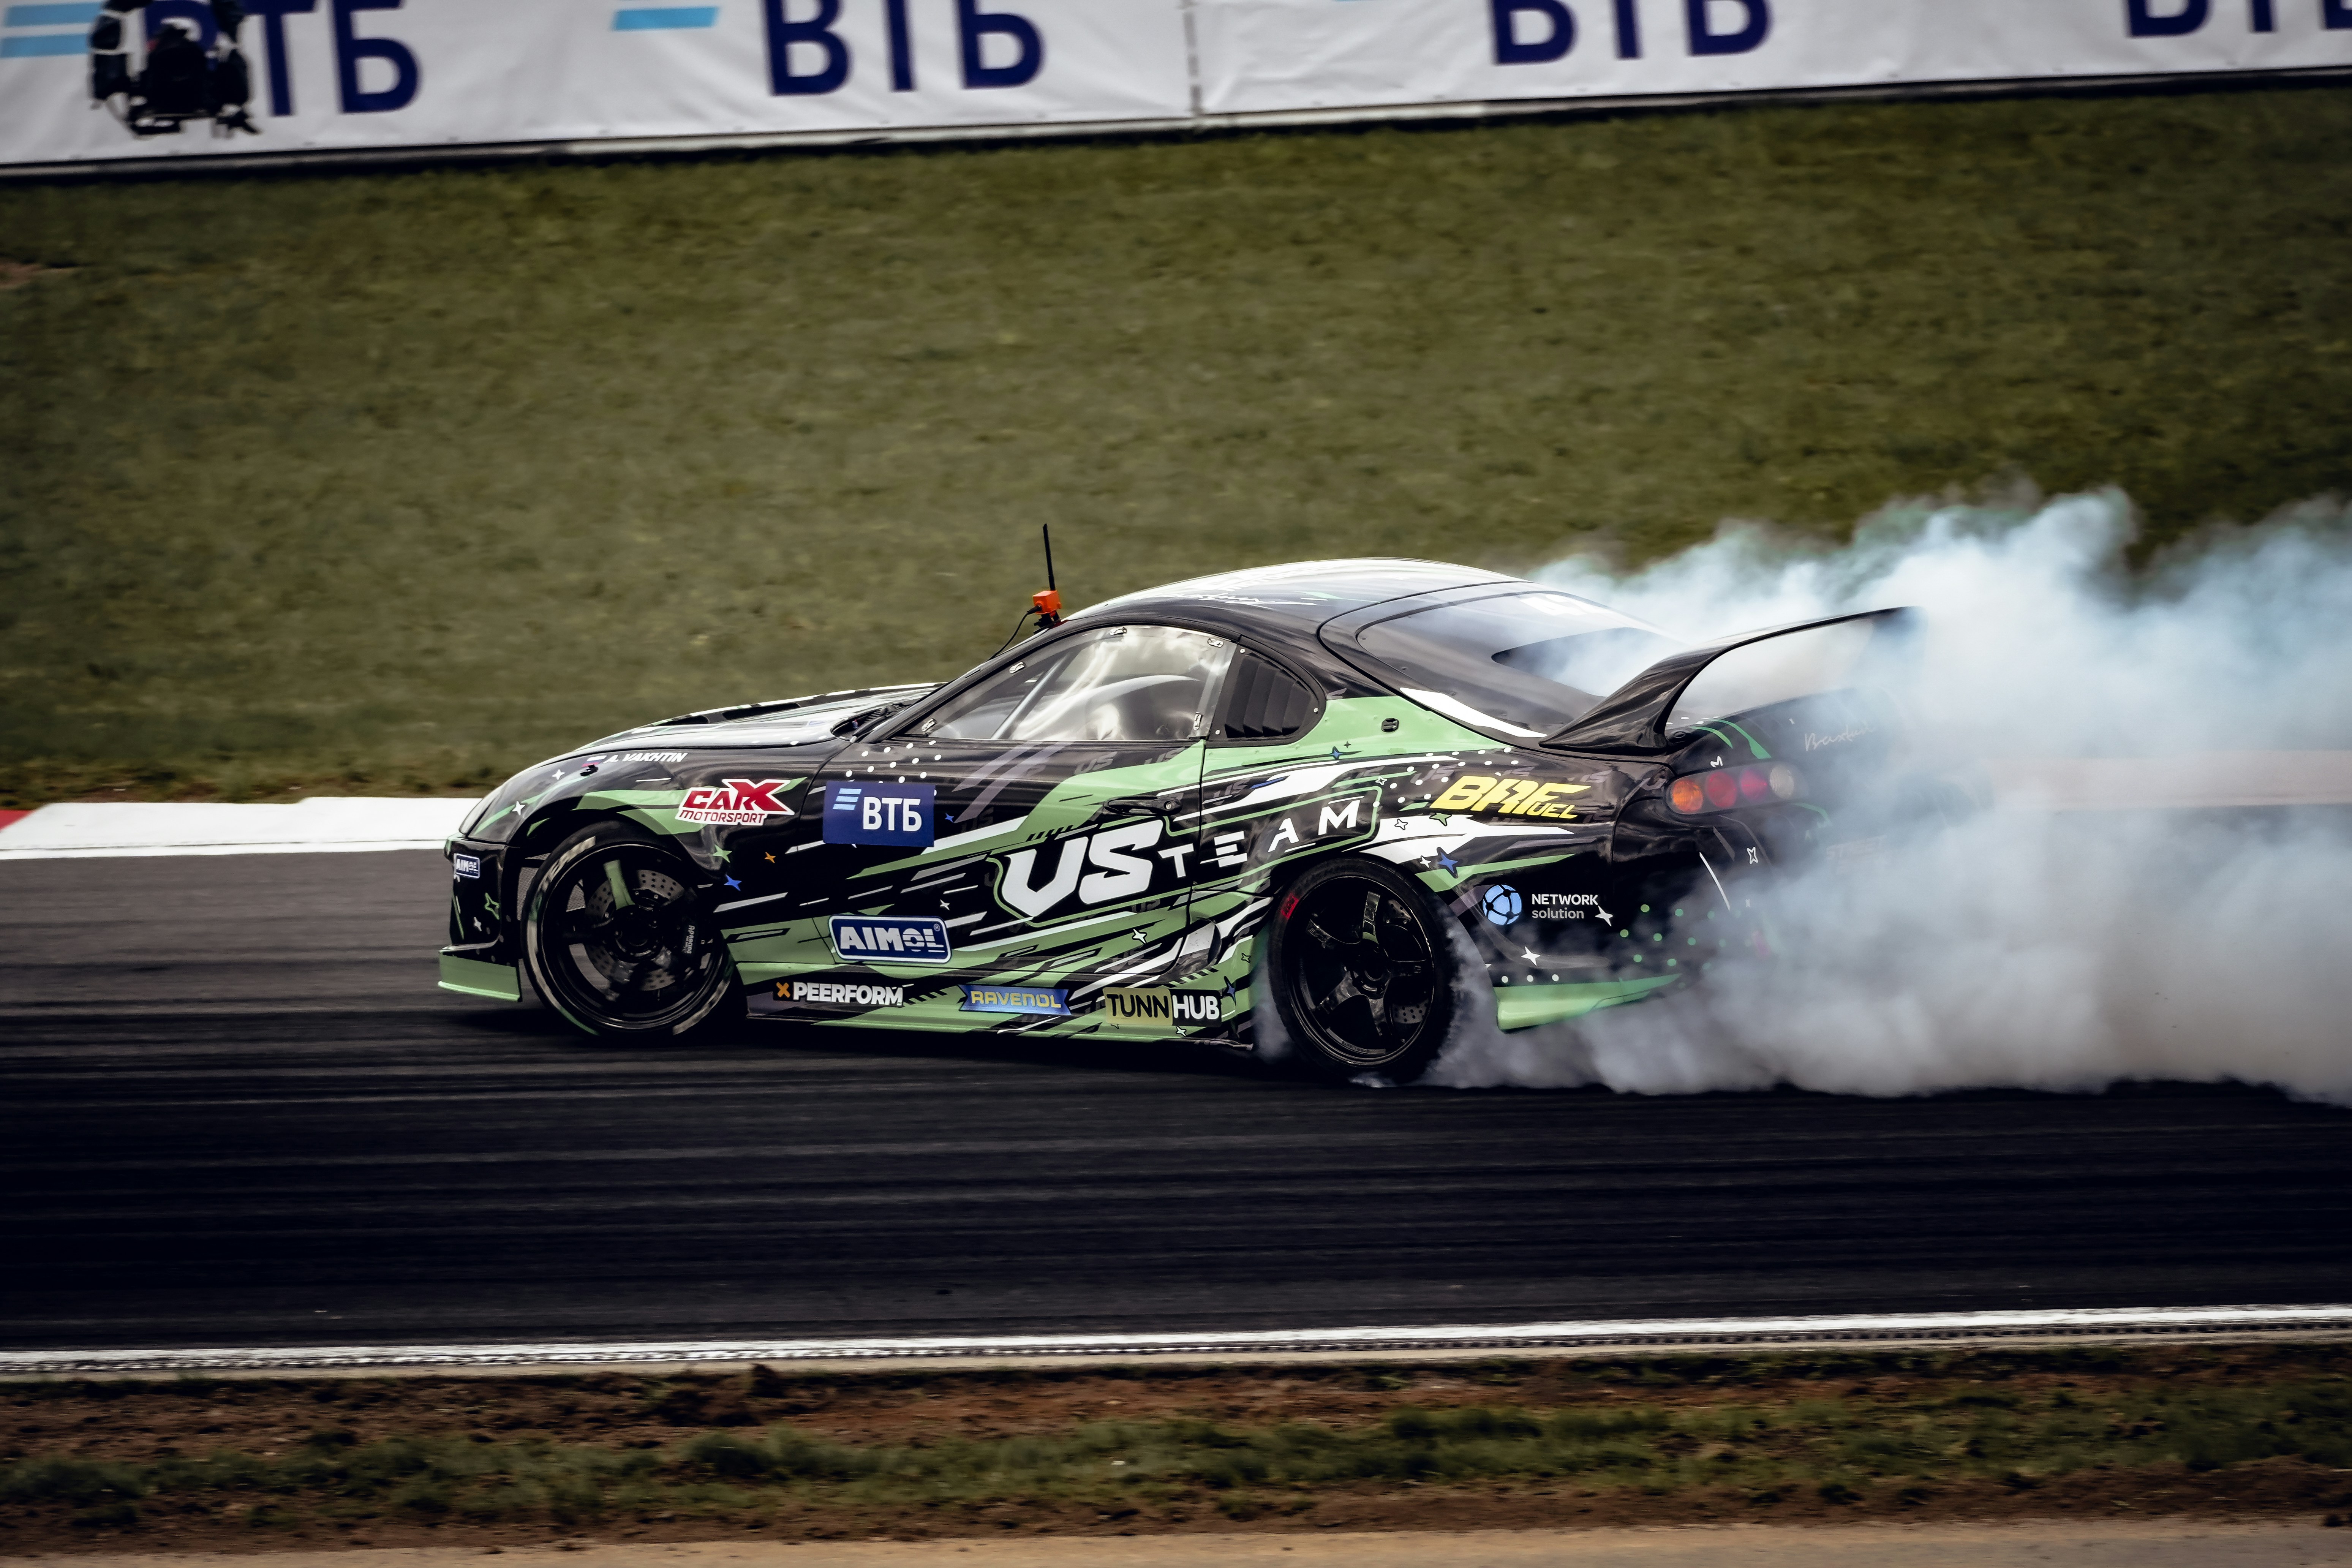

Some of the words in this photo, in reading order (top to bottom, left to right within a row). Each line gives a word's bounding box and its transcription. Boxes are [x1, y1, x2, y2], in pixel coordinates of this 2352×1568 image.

[603, 754, 619, 763] A.
[623, 752, 688, 762] VAKHTIN
[679, 809, 765, 824] MOTORSPORT
[863, 796, 923, 832] ВТБ
[1002, 819, 1164, 917] US
[1157, 800, 1360, 878] TEAM
[1532, 894, 1598, 905] NETWORK
[1532, 907, 1584, 919] solution
[971, 990, 1062, 1009] RAVENOL
